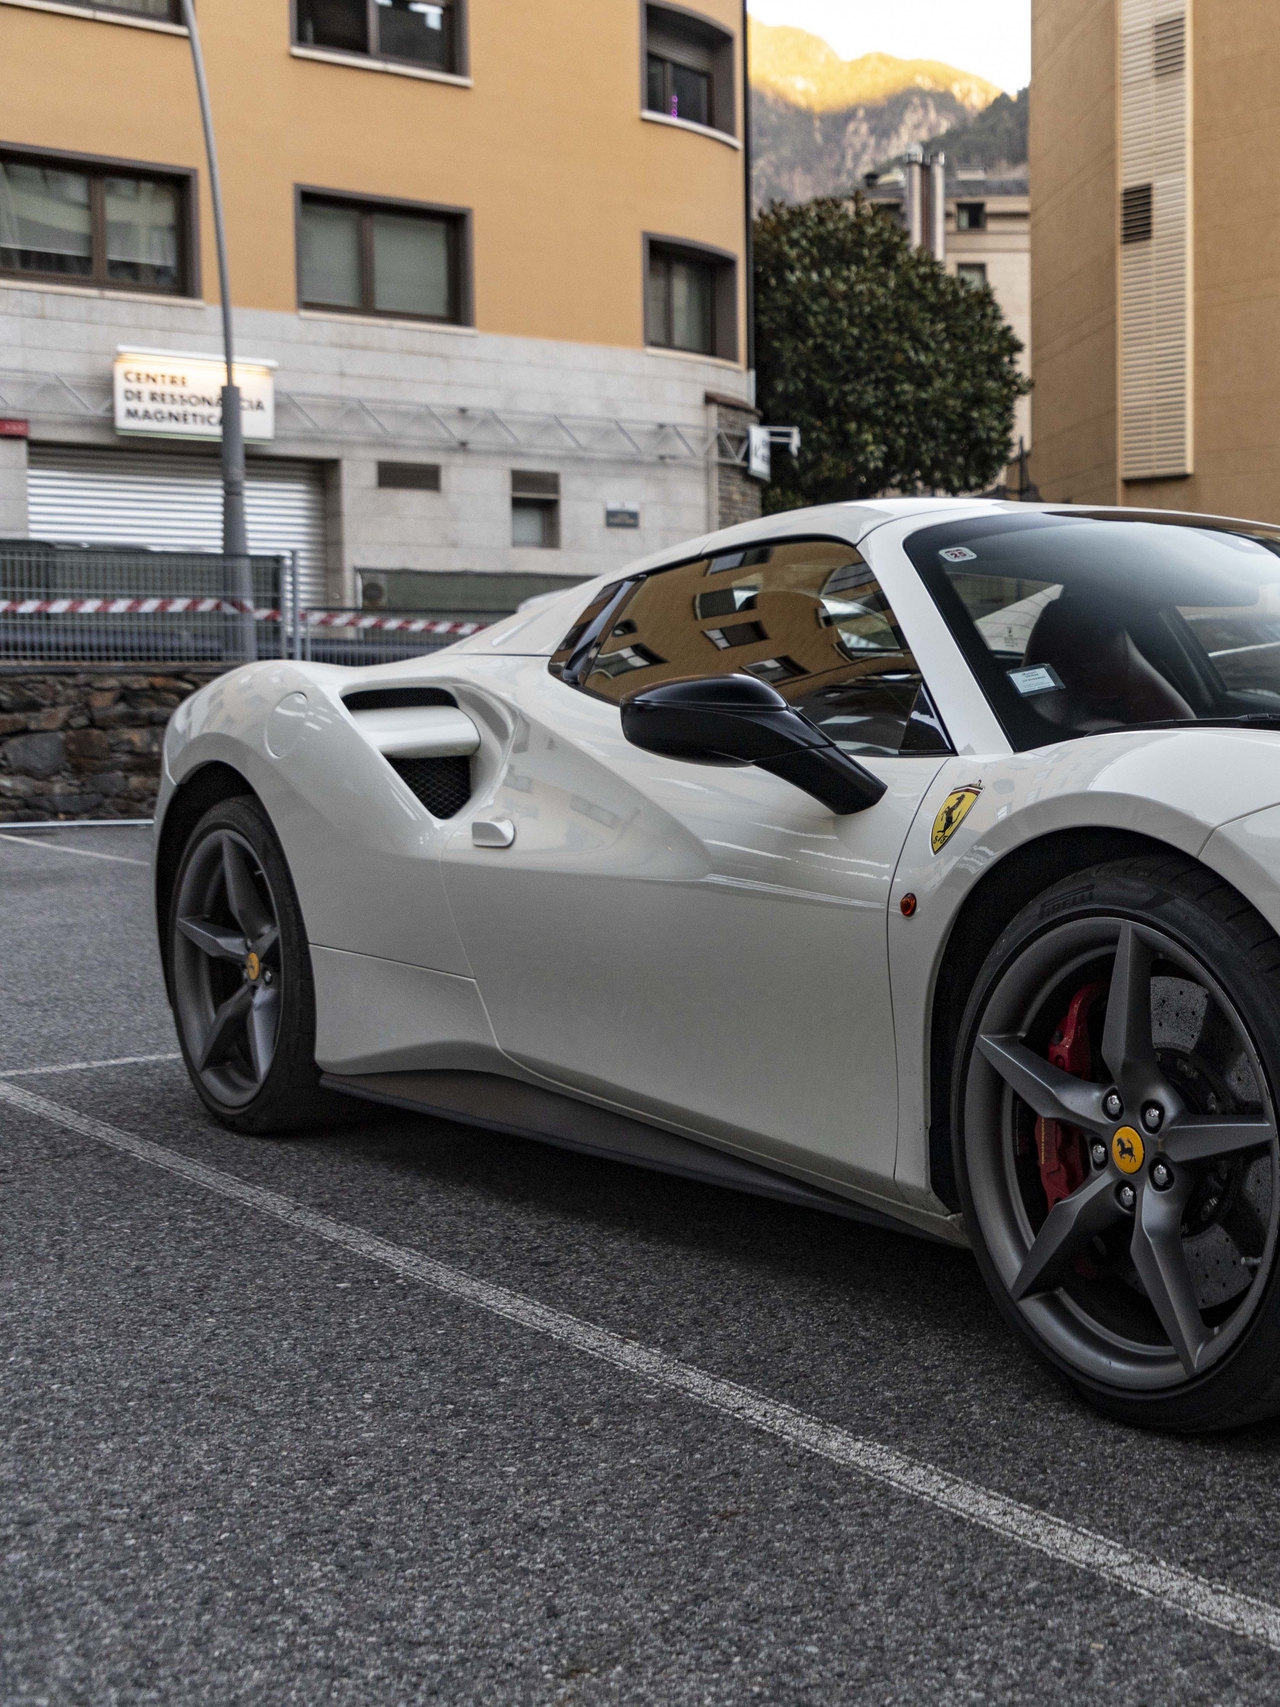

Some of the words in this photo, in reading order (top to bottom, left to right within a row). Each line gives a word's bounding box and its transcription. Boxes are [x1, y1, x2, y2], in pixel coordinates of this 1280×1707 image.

[123, 370, 188, 387] CENTRE
[124, 388, 144, 402] DE
[149, 389, 265, 412] RESSONÀCIA
[1038, 884, 1096, 920] PIRELLI
